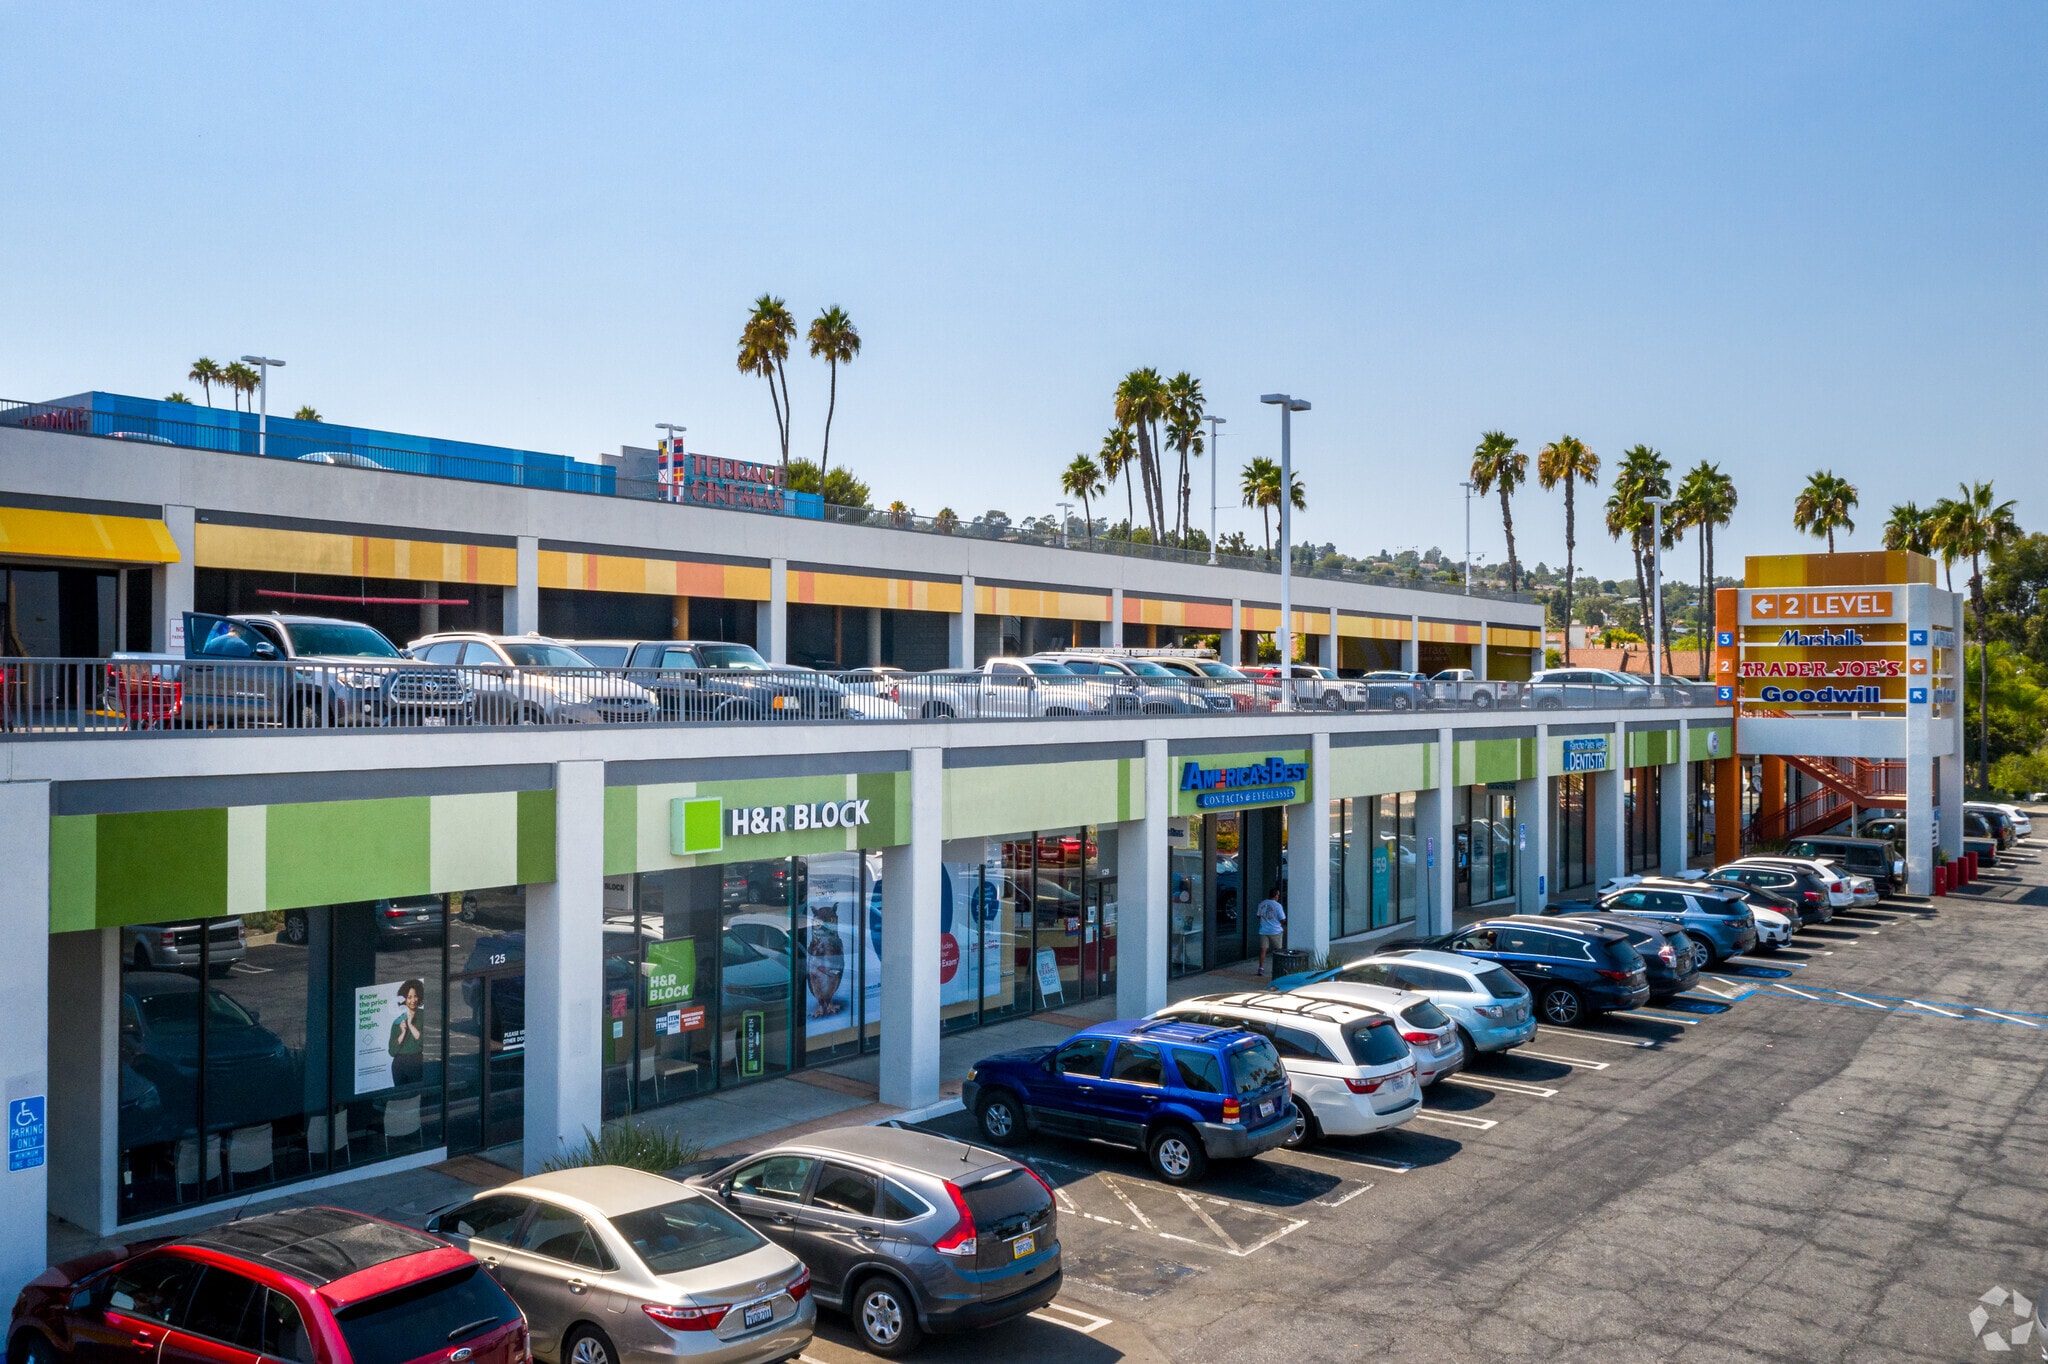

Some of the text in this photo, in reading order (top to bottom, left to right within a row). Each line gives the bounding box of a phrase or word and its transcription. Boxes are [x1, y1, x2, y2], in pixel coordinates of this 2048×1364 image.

[692, 453, 787, 486] TERRACE
[691, 480, 784, 511] CINEMAS
[1785, 595, 1885, 615] 2 LEVEL
[1721, 634, 1730, 645] 3
[1778, 629, 1863, 646] Marshalls
[1721, 661, 1730, 672] 2
[1742, 659, 1903, 677] TRADER JOE'S
[1721, 687, 1730, 698] 3
[1761, 685, 1880, 703] Goodwill
[1570, 751, 1608, 771] DENTISTRY
[1204, 788, 1295, 806] CONTACTS & EYEGLASSES
[730, 799, 870, 836] H&R BLOCK
[489, 954, 506, 964] 125
[650, 974, 677, 988] H&R
[359, 993, 378, 1001] Know
[650, 984, 690, 1001] BLOCK
[370, 999, 387, 1007] price
[359, 1021, 379, 1030] begin.
[504, 1030, 519, 1038] PLEASE
[11, 1124, 43, 1139] PARKING
[17, 1136, 37, 1149] ONLY
